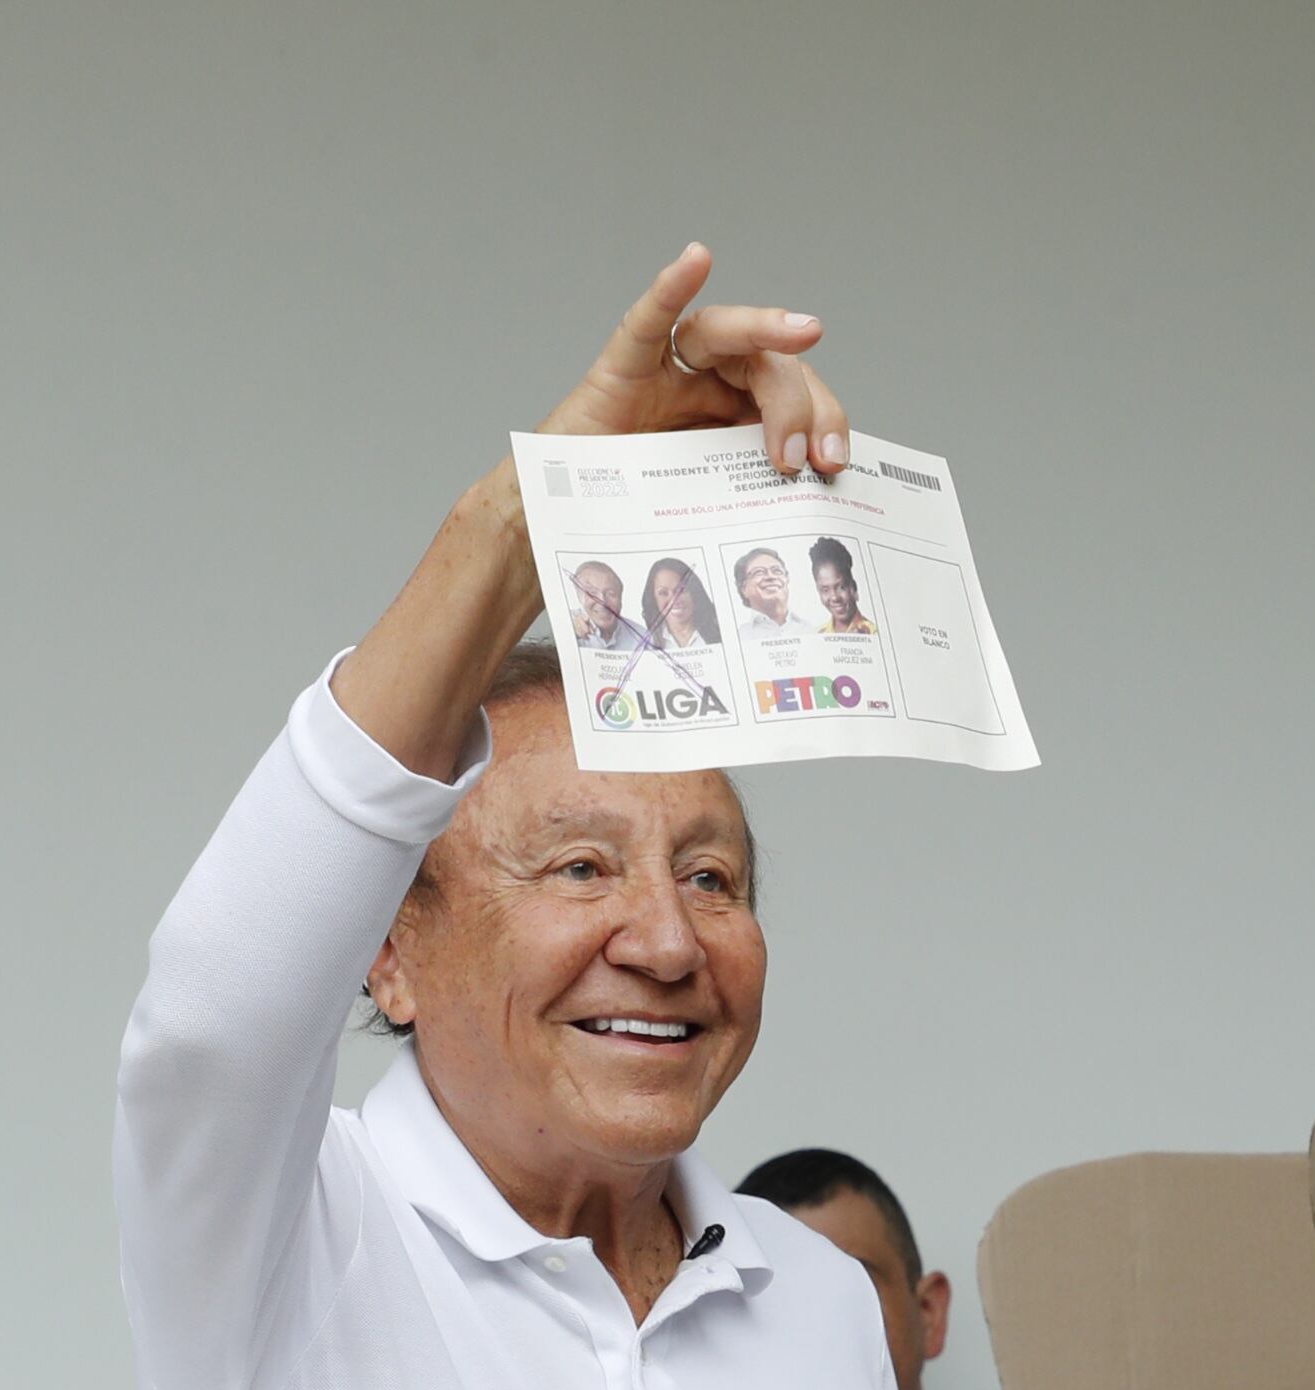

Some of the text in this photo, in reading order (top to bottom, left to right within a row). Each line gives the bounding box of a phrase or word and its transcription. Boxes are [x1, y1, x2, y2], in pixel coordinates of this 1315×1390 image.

[703, 452, 733, 463] VOTO
[736, 449, 759, 460] POR
[641, 466, 710, 478] PRESIDENTE
[713, 464, 720, 473] Y
[723, 459, 771, 472] VICEPRE
[580, 481, 629, 497] 2022
[734, 478, 788, 492] SEGUNDA
[654, 507, 689, 517] MARQUE
[715, 503, 733, 512] UNA
[778, 493, 831, 504] PRESIDENCIAL
[636, 685, 729, 720] LIGA
[754, 675, 861, 714] PETRO
